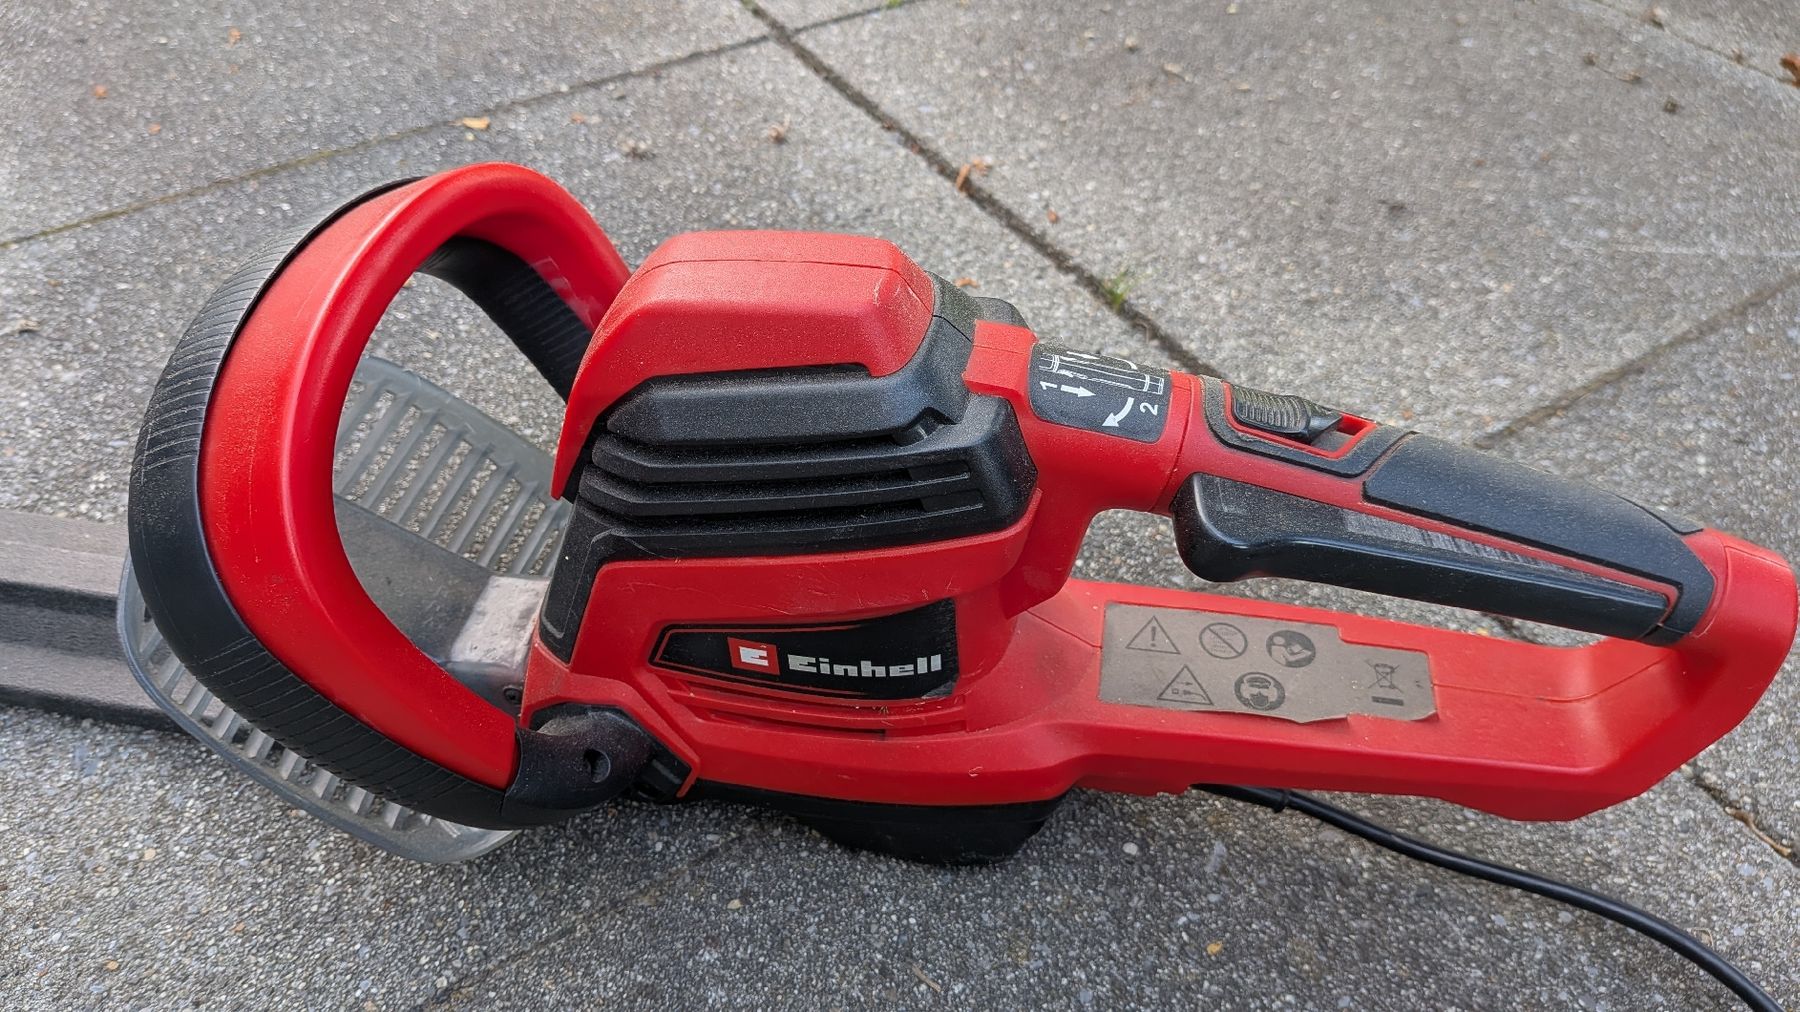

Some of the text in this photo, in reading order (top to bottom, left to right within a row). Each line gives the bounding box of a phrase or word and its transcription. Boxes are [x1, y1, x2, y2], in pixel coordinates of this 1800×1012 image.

[1039, 381, 1057, 390] 1
[1139, 402, 1159, 416] 2
[788, 654, 941, 677] Einhell
